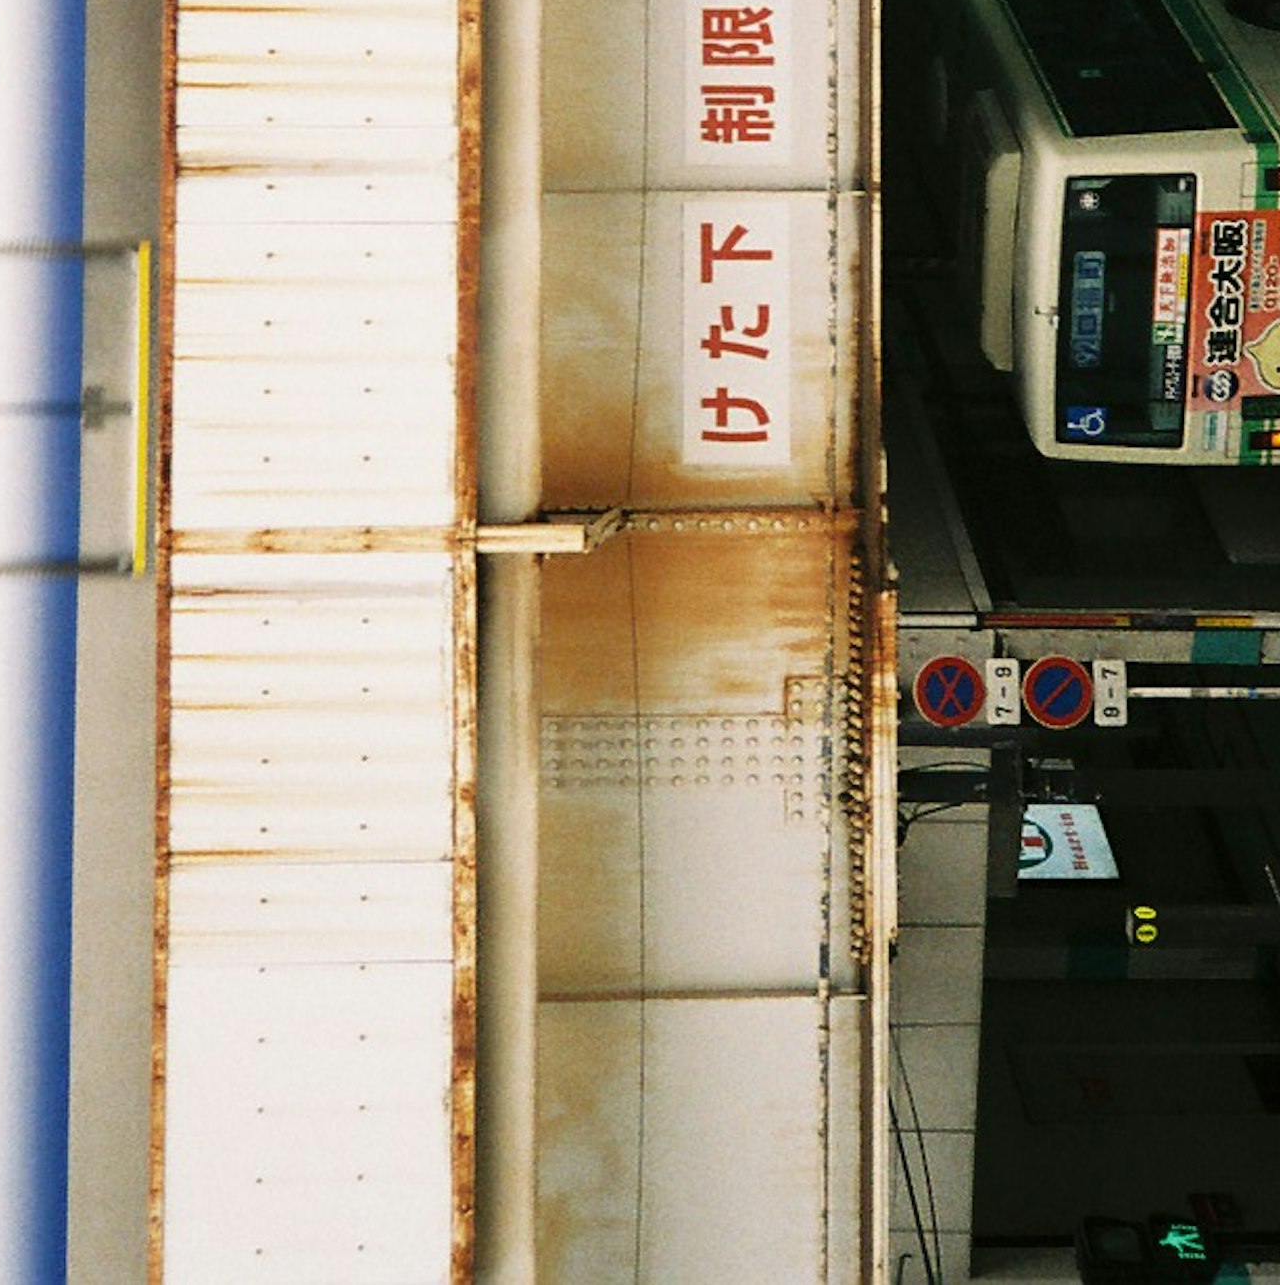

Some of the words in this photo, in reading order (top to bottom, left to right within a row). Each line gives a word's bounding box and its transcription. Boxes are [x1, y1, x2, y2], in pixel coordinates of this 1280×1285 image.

[700, 222, 773, 443] けた下
[1205, 221, 1246, 366] 連合大阪
